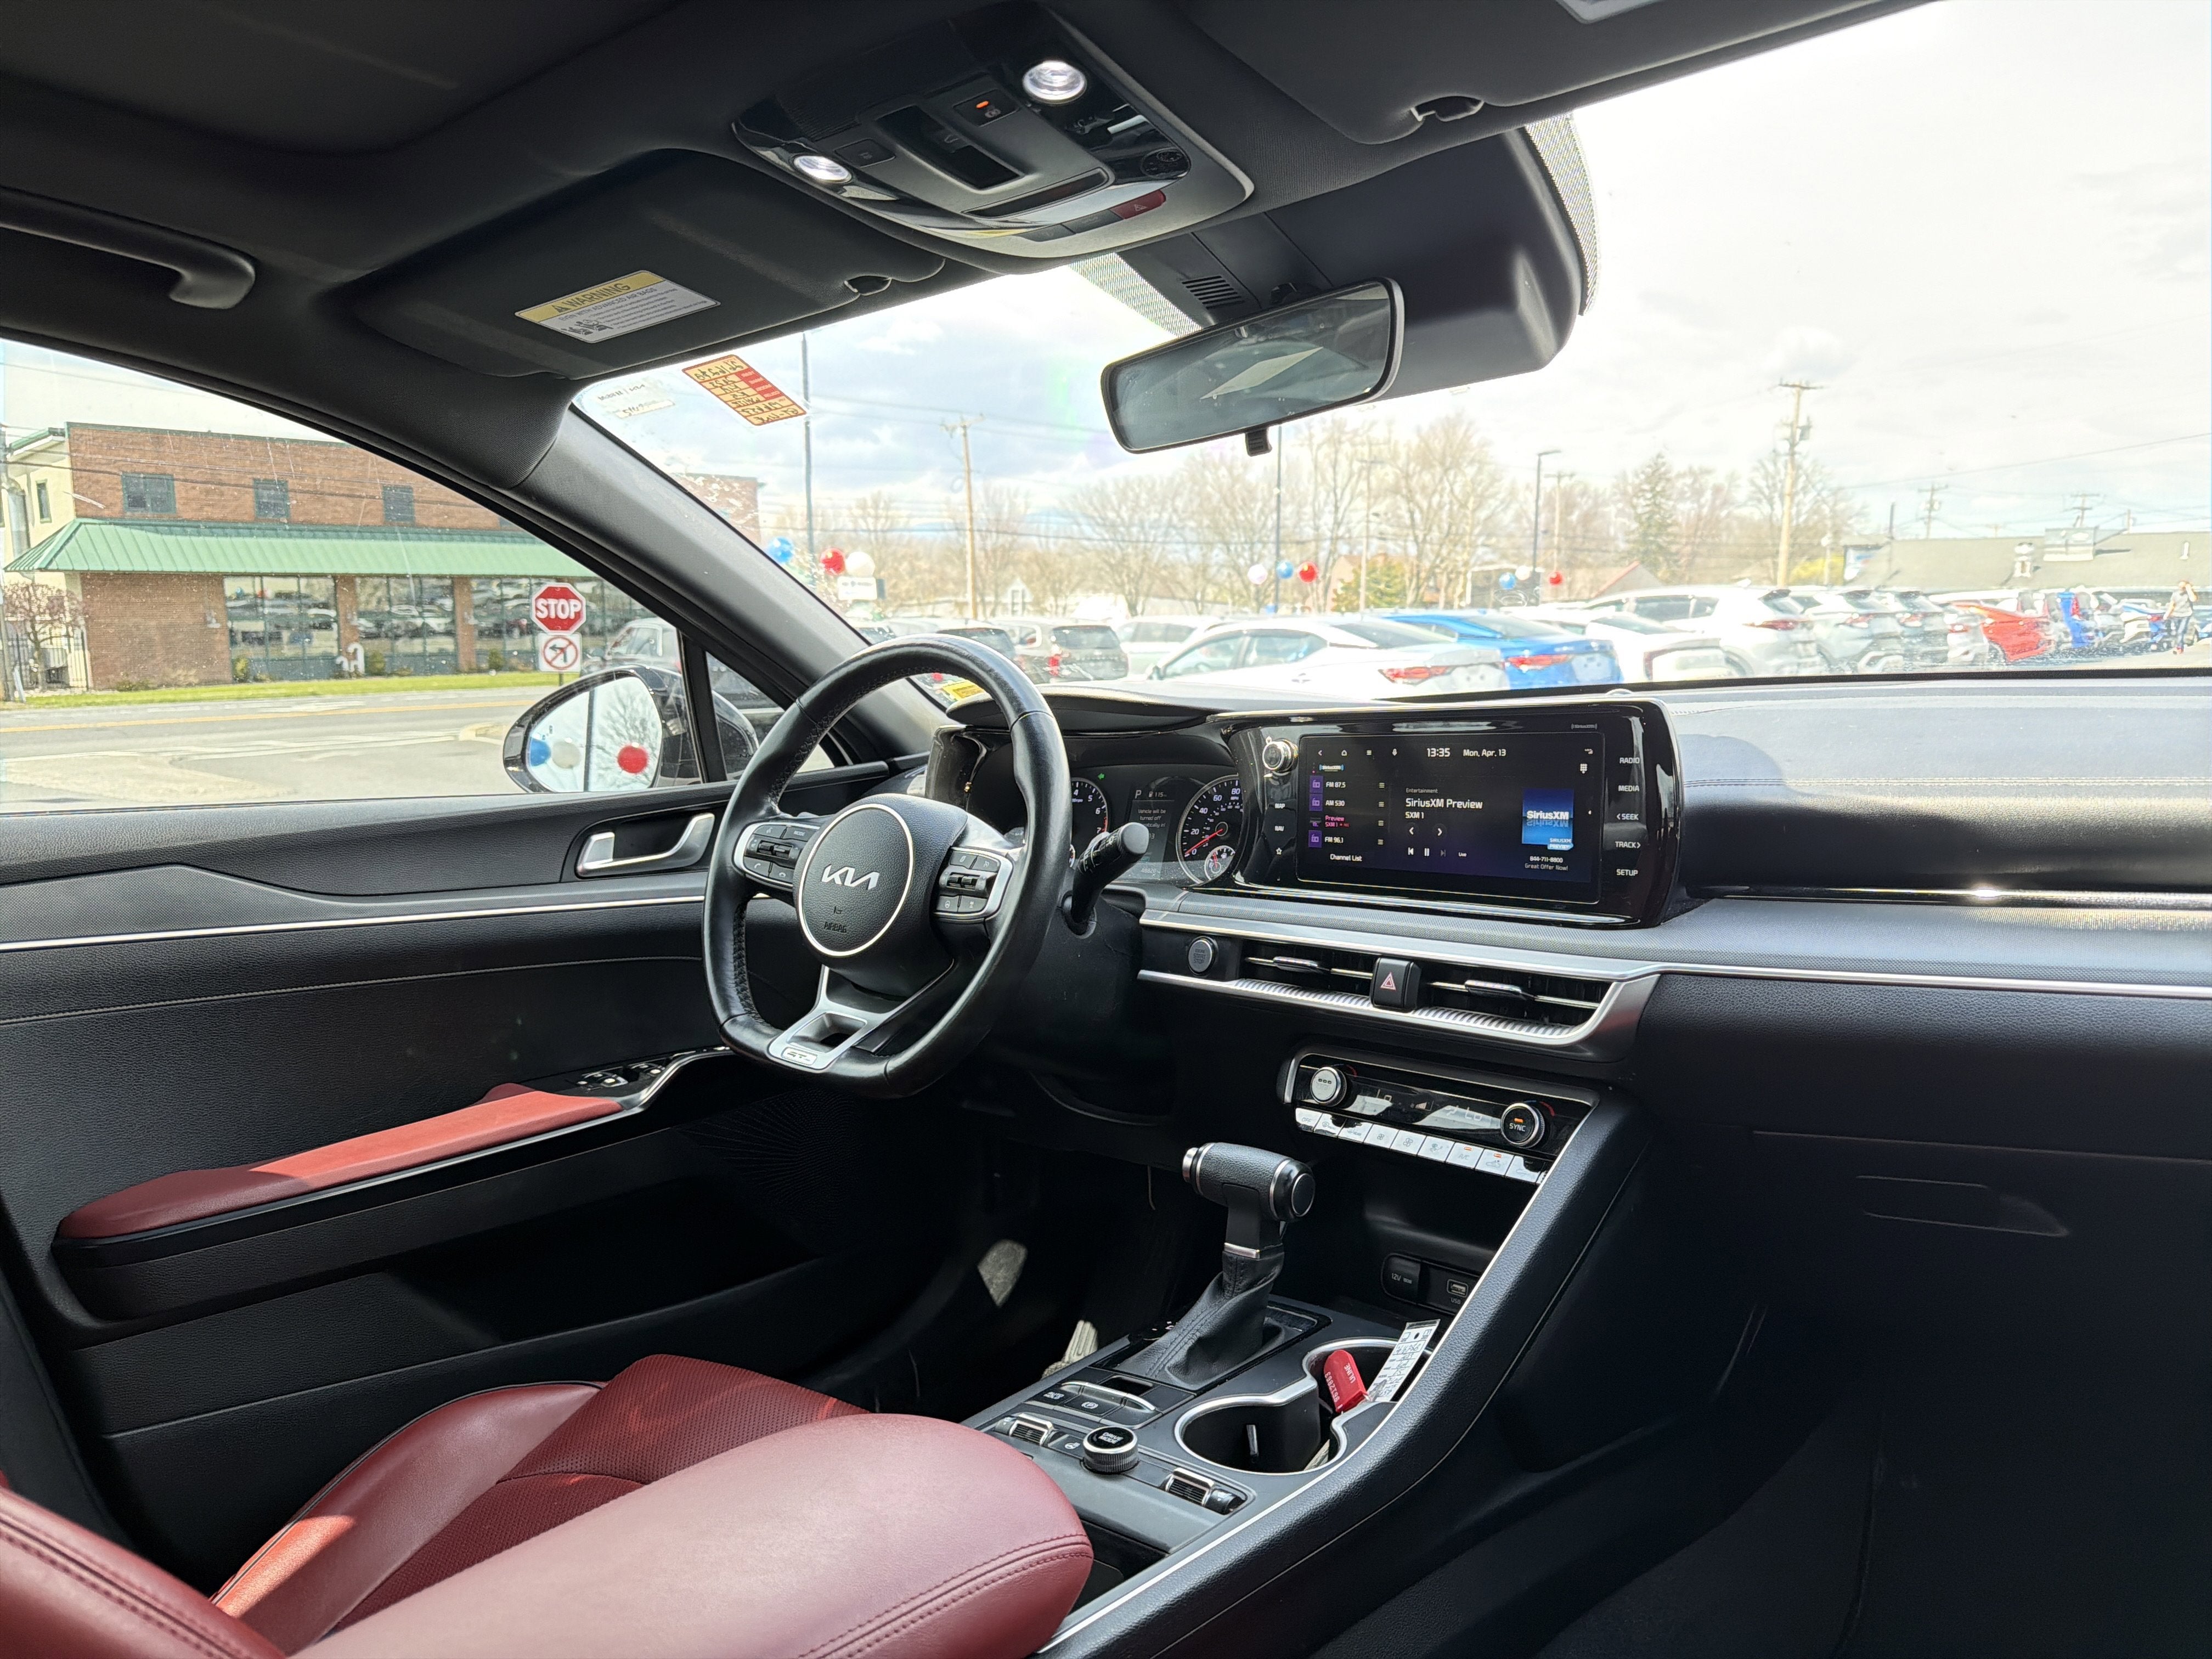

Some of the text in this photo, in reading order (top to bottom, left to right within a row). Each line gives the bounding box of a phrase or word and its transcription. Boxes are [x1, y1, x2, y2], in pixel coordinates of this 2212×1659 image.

[565, 283, 631, 308] WARNING
[591, 297, 628, 312] ADVANCED
[627, 293, 639, 301] AIR
[639, 287, 657, 297] BAGS
[535, 597, 582, 619] STOP
[1427, 748, 1451, 757] 13:35
[1481, 749, 1497, 758] Apr.
[1135, 790, 1142, 799] P
[1406, 798, 1483, 809] SiriusXM Preview
[1527, 810, 1569, 820] SiriusXM
[824, 922, 847, 933] AIRBAG
[1509, 1123, 1526, 1132] SYNC
[1391, 1273, 1401, 1281] 12V
[1344, 1363, 1356, 1384] ULINE
[1325, 1372, 1340, 1403] 9612863
[1098, 1436, 1118, 1444] MODE
[1102, 1432, 1124, 1441] DRIVE
